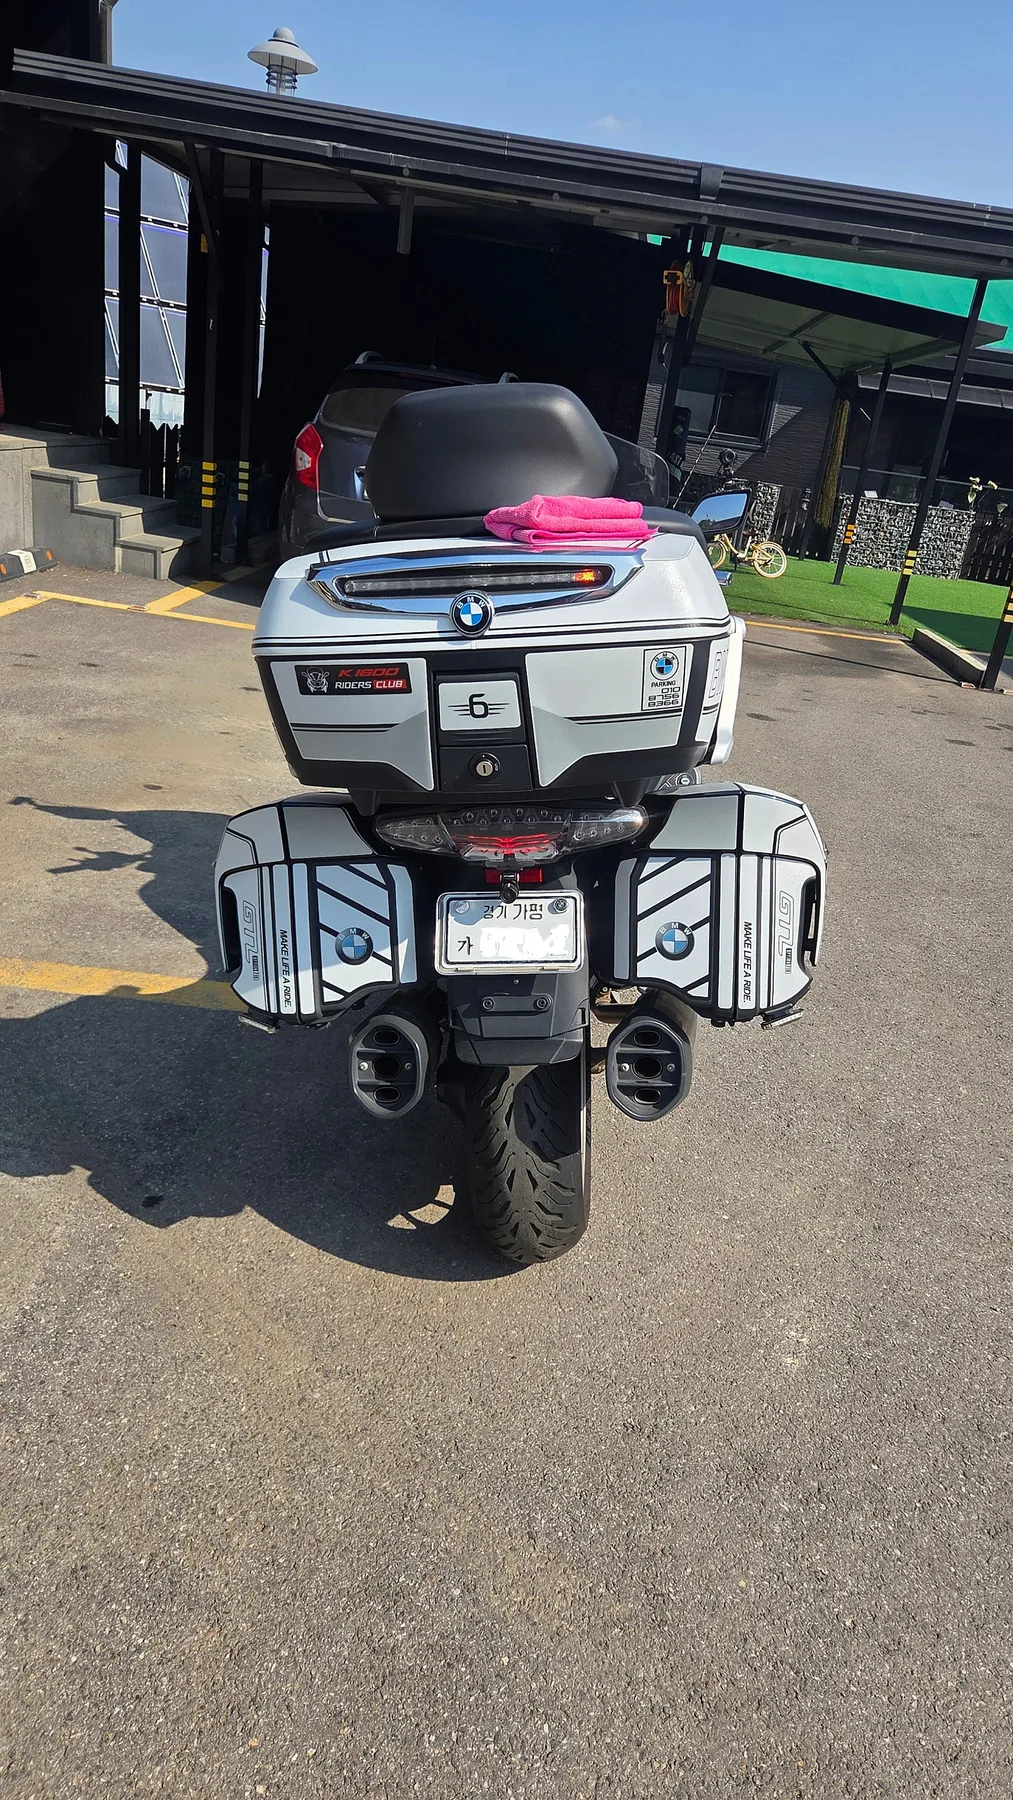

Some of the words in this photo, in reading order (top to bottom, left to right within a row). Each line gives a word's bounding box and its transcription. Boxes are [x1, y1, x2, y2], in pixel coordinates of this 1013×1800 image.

[335, 681, 372, 690] RIDERS
[375, 680, 403, 689] CLUB
[651, 680, 677, 688] PARKING
[661, 686, 681, 694] 010
[468, 693, 490, 719] 6
[648, 700, 679, 708] 8366
[483, 904, 508, 919] 경기
[513, 903, 543, 920] 가평
[778, 890, 795, 957] GTL
[280, 929, 289, 957] MAKE
[743, 921, 753, 950] MAKE
[457, 936, 474, 956] 가
[281, 957, 290, 976] LIFE
[743, 950, 752, 971] LIFE
[282, 976, 291, 984] A
[743, 970, 752, 978] A
[283, 985, 292, 1008] RIDE.
[743, 979, 752, 1003] RIDE.
